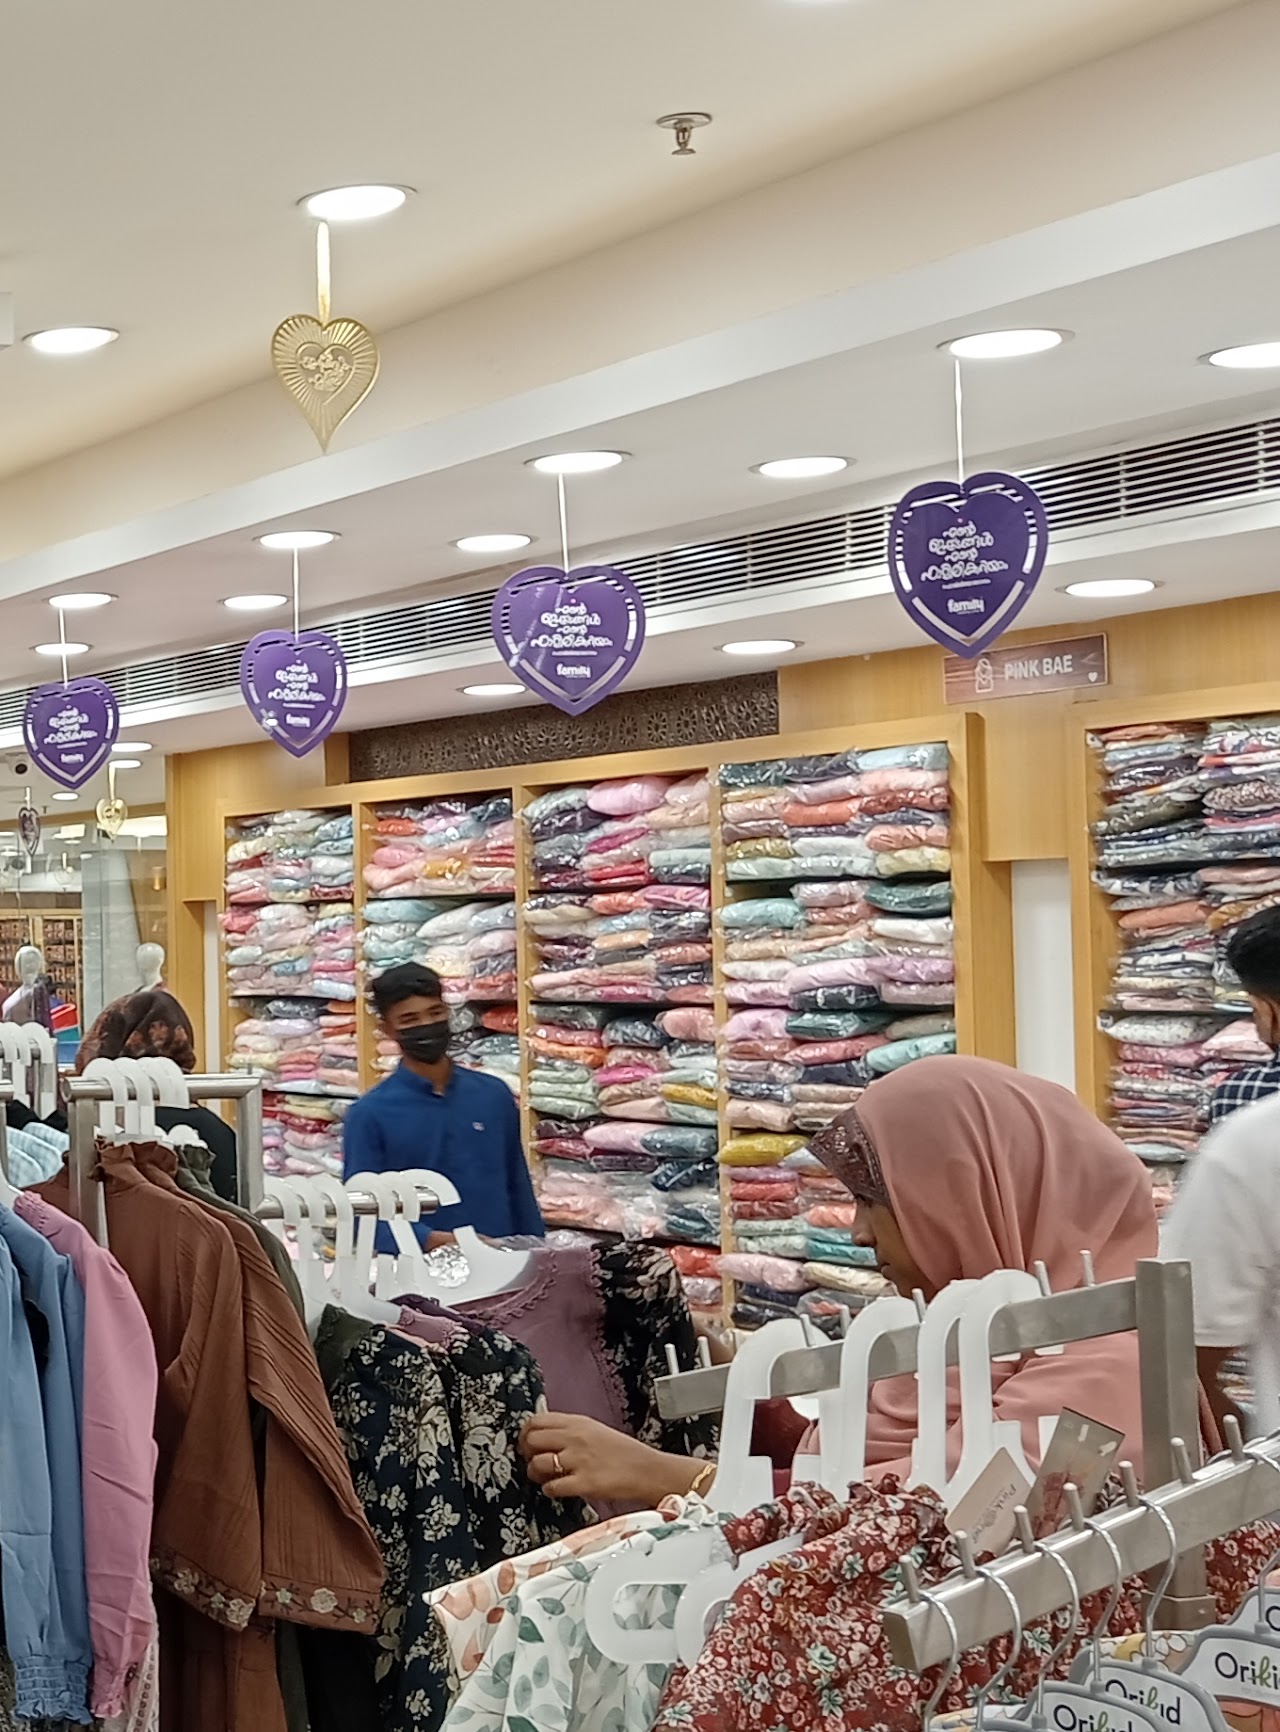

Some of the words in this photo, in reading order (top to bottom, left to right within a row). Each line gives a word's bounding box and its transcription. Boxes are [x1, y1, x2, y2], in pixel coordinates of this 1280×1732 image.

[1003, 659, 1040, 680] PINK
[1042, 654, 1074, 676] BAE
[1215, 1652, 1280, 1691] Oriki
